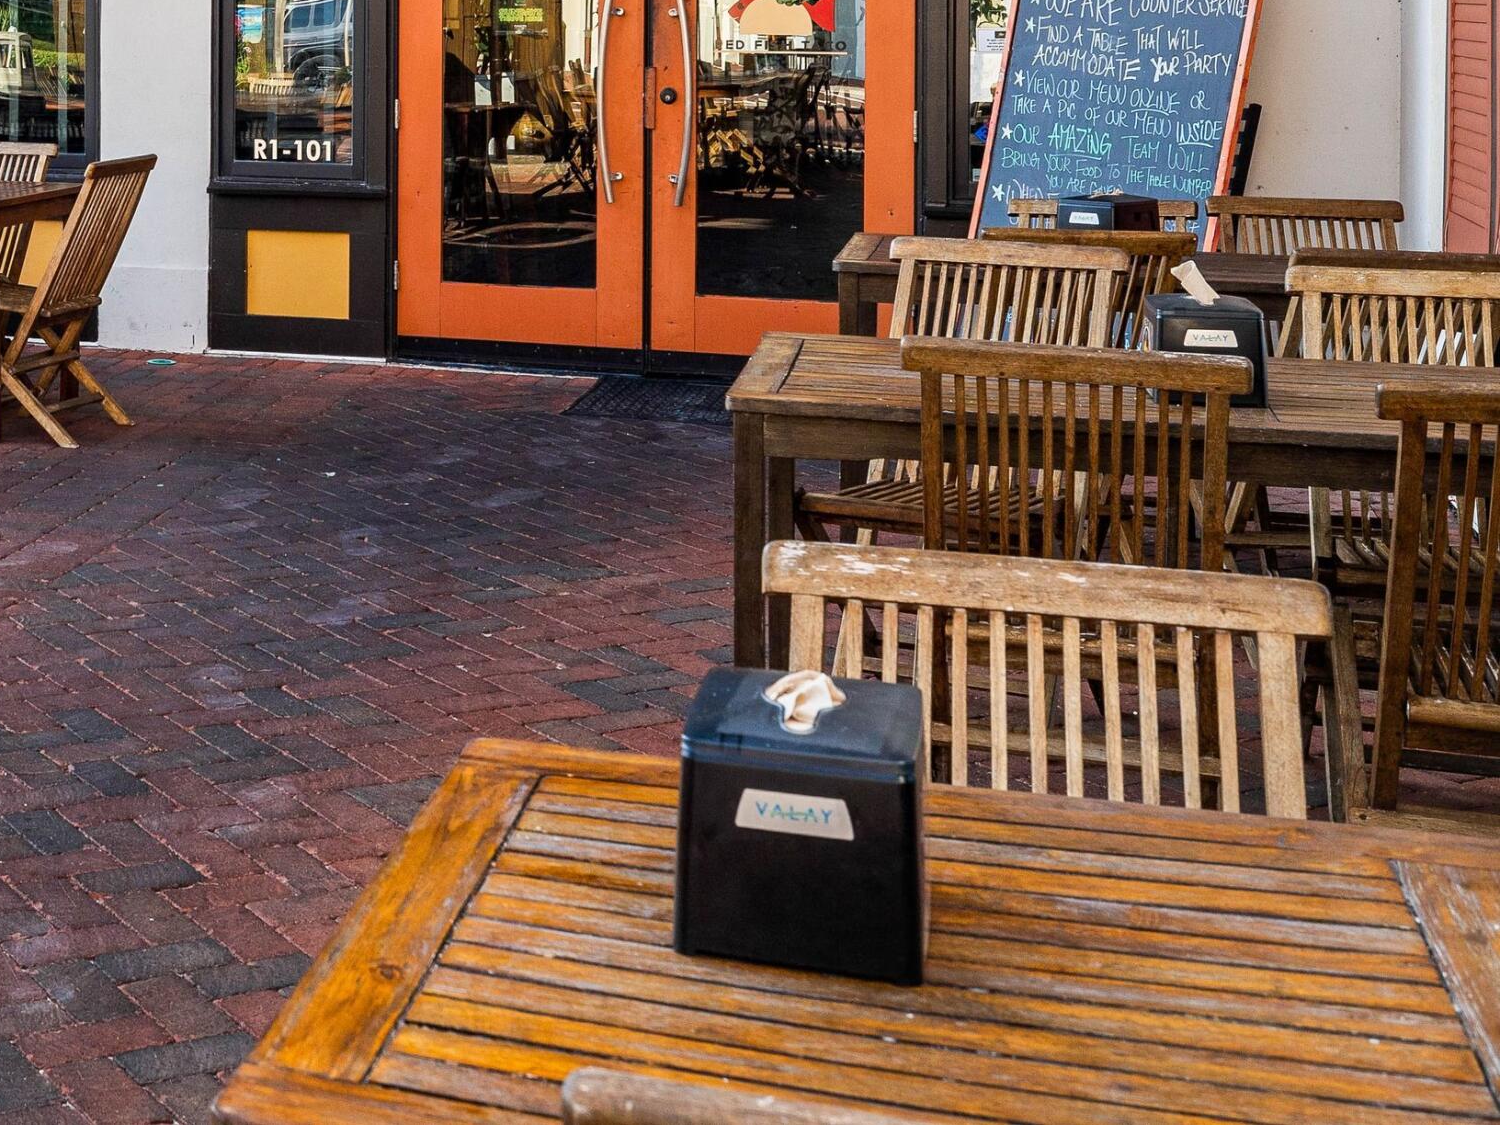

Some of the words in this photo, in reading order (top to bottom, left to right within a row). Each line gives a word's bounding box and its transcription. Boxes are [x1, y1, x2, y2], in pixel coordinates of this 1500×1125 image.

[1036, 15, 1070, 44] FIND
[1072, 26, 1084, 46] A
[1087, 27, 1129, 55] TABLE
[1132, 24, 1164, 54] THAT
[1167, 27, 1204, 51] WILL
[1032, 43, 1141, 82] ACCOMMODATE
[1150, 56, 1180, 83] YOUR
[1183, 50, 1233, 77] PARTY
[1025, 70, 1056, 98] VIEW
[1056, 79, 1084, 101] OUR
[1088, 80, 1127, 105] MENU
[1130, 87, 1181, 115] ONLINE
[1190, 90, 1211, 110] OR
[1011, 93, 1037, 116] TAKE
[1042, 102, 1052, 114] A
[1057, 100, 1077, 120] PIC
[1084, 106, 1103, 127] OF
[1105, 112, 1128, 129] OUR
[1133, 110, 1172, 138] MENU
[1176, 119, 1224, 143] INSIDE
[254, 138, 332, 162] R1-101
[1012, 124, 1044, 146] OUR
[1048, 123, 1113, 159] AMAZING
[1121, 135, 1160, 164] TEAM
[1167, 145, 1211, 173] WILL
[1001, 147, 1041, 168] BRING
[1045, 152, 1072, 175] YOUR
[1075, 158, 1103, 179] FOOD
[1107, 163, 1121, 179] TO
[1122, 164, 1145, 184] THE
[1146, 166, 1171, 191] TABLE
[1172, 174, 1214, 199] NUMBER
[1045, 174, 1064, 189] YOU
[1066, 178, 1086, 192] ARE
[1192, 334, 1229, 342] VALAY
[755, 802, 834, 825] VALAY
